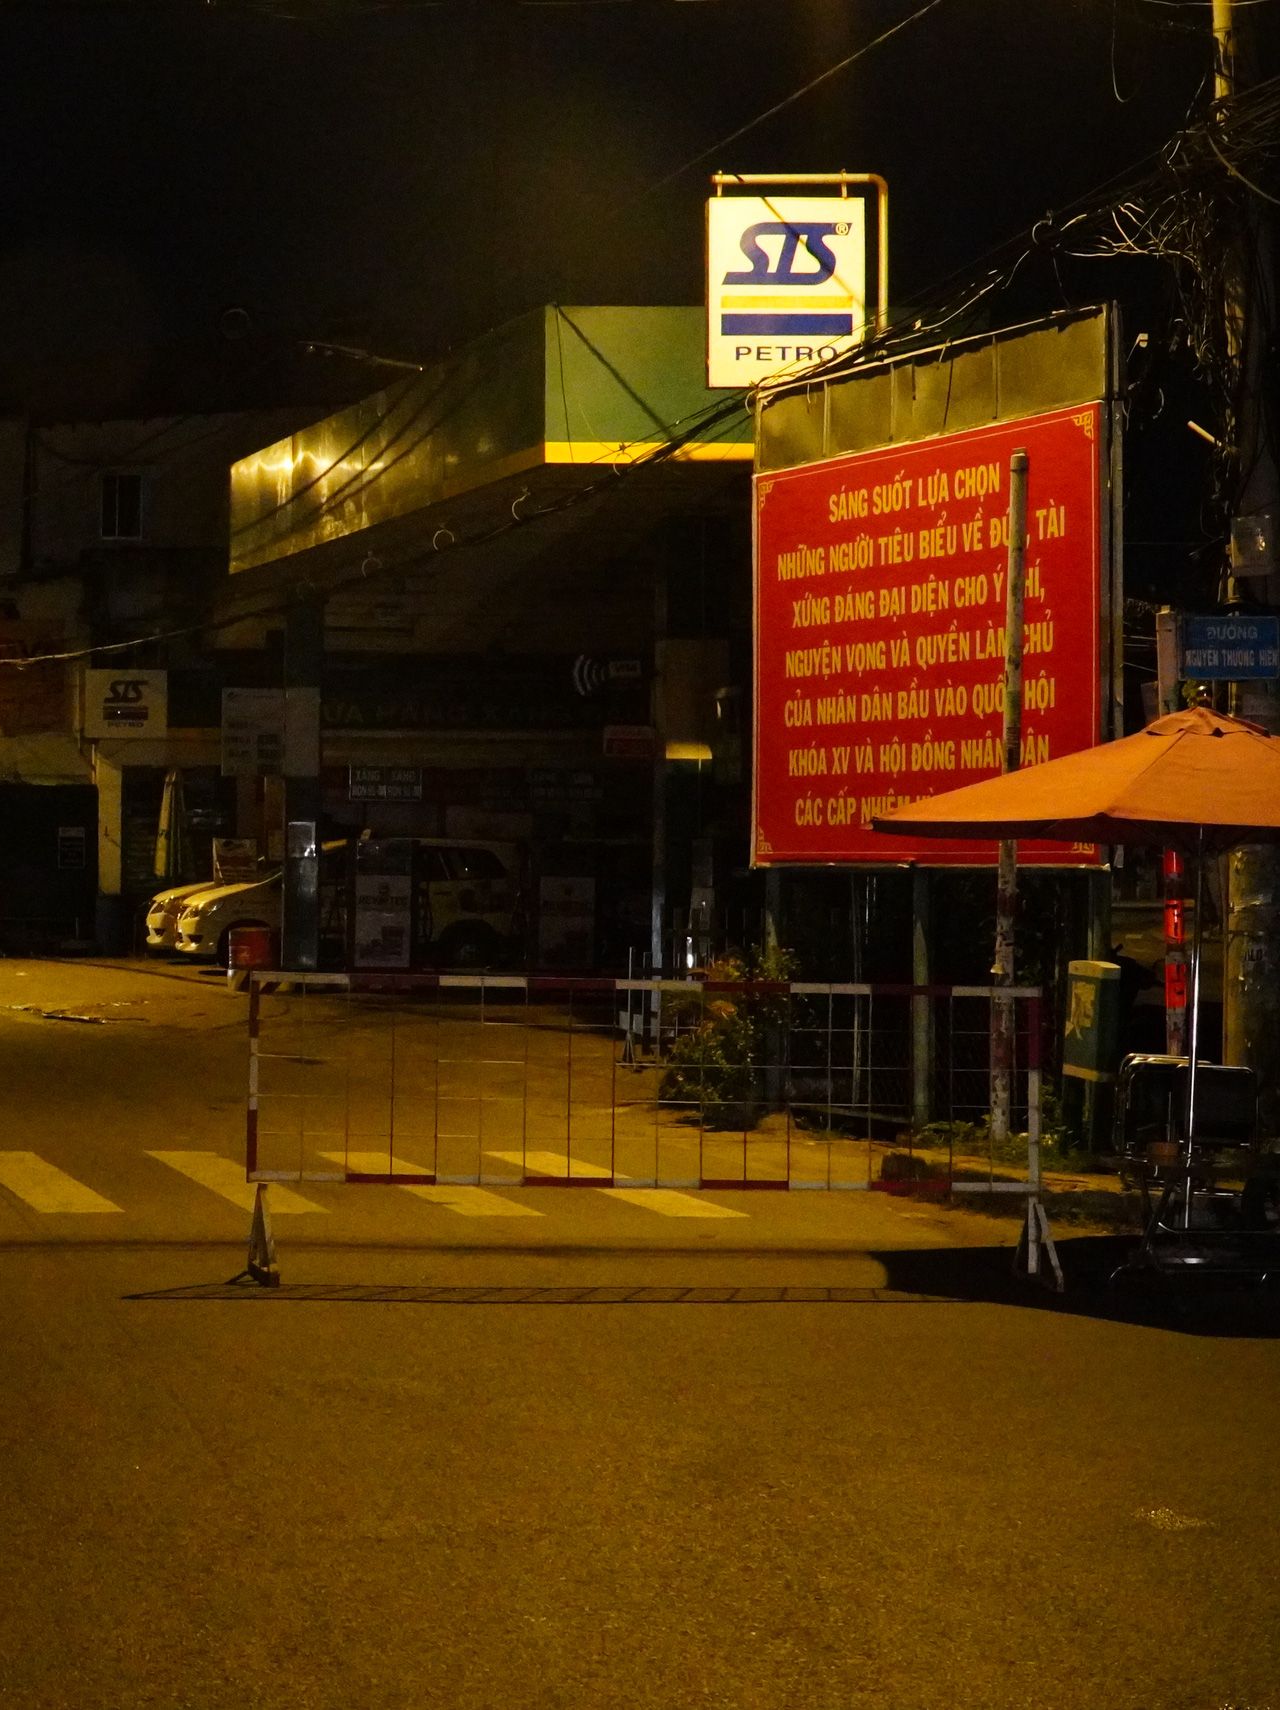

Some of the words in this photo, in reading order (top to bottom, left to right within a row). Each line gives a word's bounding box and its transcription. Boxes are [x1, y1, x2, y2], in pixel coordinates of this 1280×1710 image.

[735, 346, 838, 361] PETRO
[829, 485, 868, 523] SÁNG
[872, 469, 913, 515] SUỐT
[918, 468, 949, 511] LỰA
[954, 462, 1000, 502] CHỌN
[778, 544, 825, 581] NHỮNG
[829, 533, 874, 573] NGƯỜI
[878, 527, 914, 565] TIÊU
[919, 511, 957, 560] BIỂU
[962, 507, 983, 552] VỀ
[990, 507, 1030, 549] ĐỨ,
[1036, 498, 1065, 540] TÀI
[792, 592, 830, 628] XỨNG
[834, 585, 875, 623] ĐÁNG
[879, 586, 906, 622] ĐẠI
[911, 574, 949, 617] DIỆN
[954, 574, 988, 608] CHO
[993, 563, 1004, 602] Ý
[1024, 558, 1045, 603] HÍ,
[785, 639, 841, 680] NGUYỆN
[846, 641, 886, 677] VỌNG
[890, 630, 910, 668] VÀ
[916, 619, 970, 670] QUYỀN
[1206, 622, 1258, 640] ĐƯỜNG
[784, 689, 812, 727] CỦA
[817, 689, 856, 725] NHÂN
[861, 685, 893, 722] DÂN
[897, 677, 929, 720] BẦU
[935, 678, 967, 717] VÀO
[972, 674, 1006, 719] QUỐ
[1024, 669, 1055, 715] HỘI
[789, 740, 827, 777] KHÓA
[832, 747, 850, 775] XV
[855, 737, 874, 773] VÀ
[880, 736, 906, 778] HỘI
[911, 729, 956, 772] ĐỒNG
[961, 730, 1004, 769] NHÂN
[1020, 727, 1049, 765] ÂN
[795, 790, 822, 826] CÁC
[827, 786, 856, 825] CẤP
